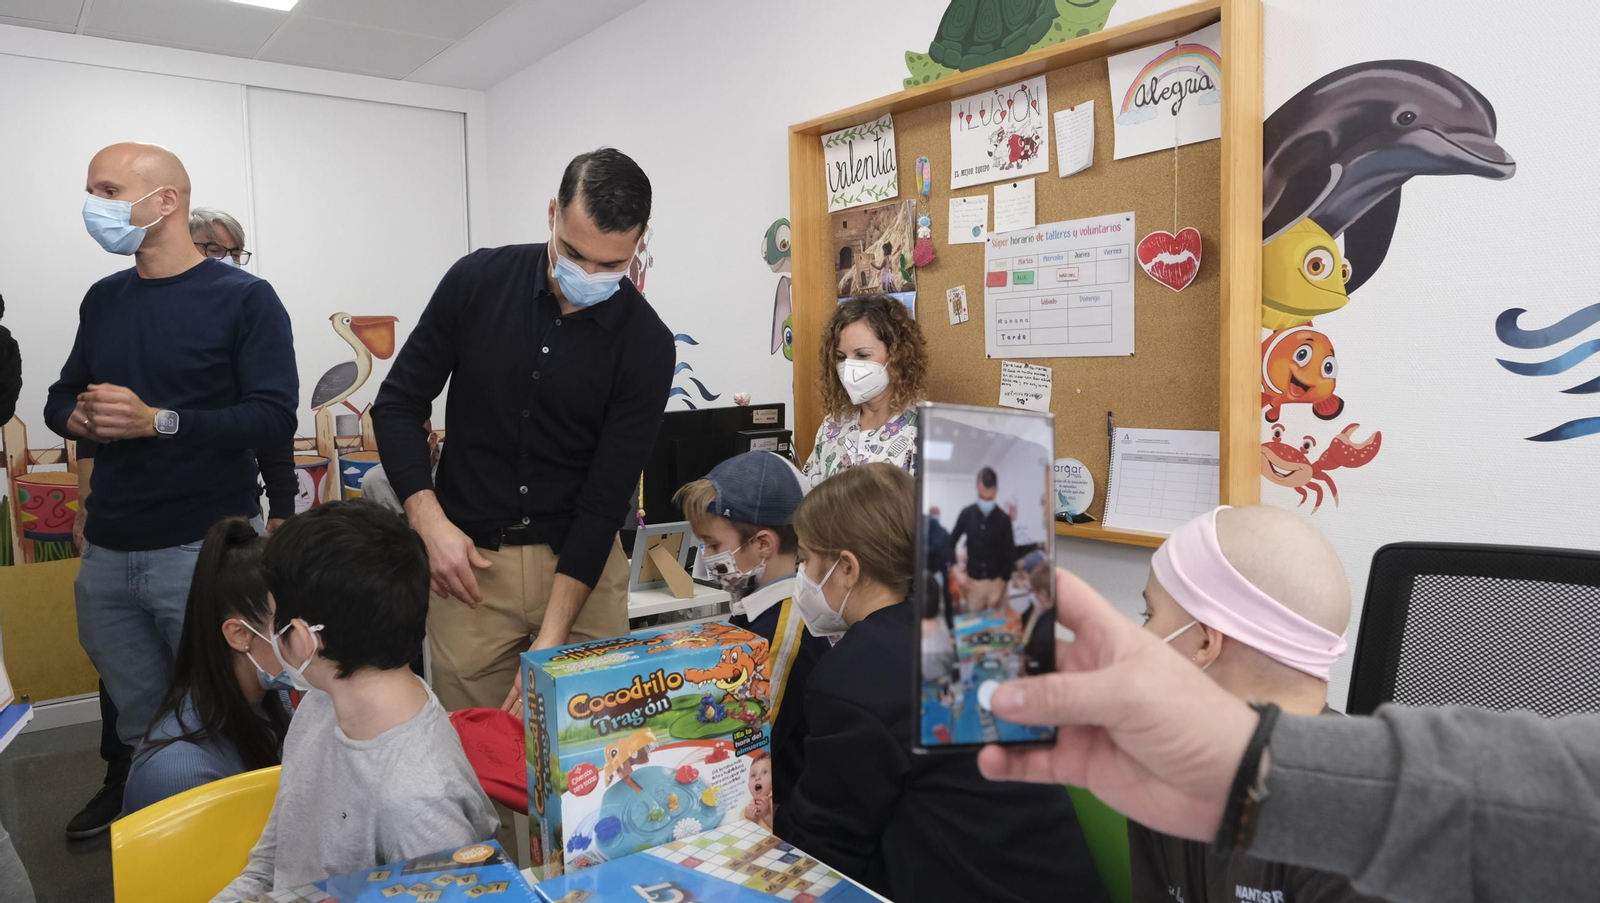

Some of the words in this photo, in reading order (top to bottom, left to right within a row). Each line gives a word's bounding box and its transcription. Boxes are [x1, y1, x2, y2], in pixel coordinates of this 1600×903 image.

[960, 167, 974, 177] MEJOR
[975, 164, 990, 174] EQUIPO
[1010, 234, 1035, 246] horario
[1035, 232, 1044, 242] de
[1045, 229, 1071, 241] talleres
[1072, 229, 1078, 239] y
[1079, 223, 1122, 237] voluntarios
[1017, 257, 1034, 266] Martes
[1074, 251, 1091, 260] Jueves
[1103, 247, 1123, 256] Viernes
[1079, 295, 1101, 304] Domingo
[1001, 333, 1027, 341] Tarde
[568, 669, 684, 718] Cocodrilo
[592, 698, 670, 734] Tragón
[735, 738, 751, 748] hora
[751, 732, 762, 741] del
